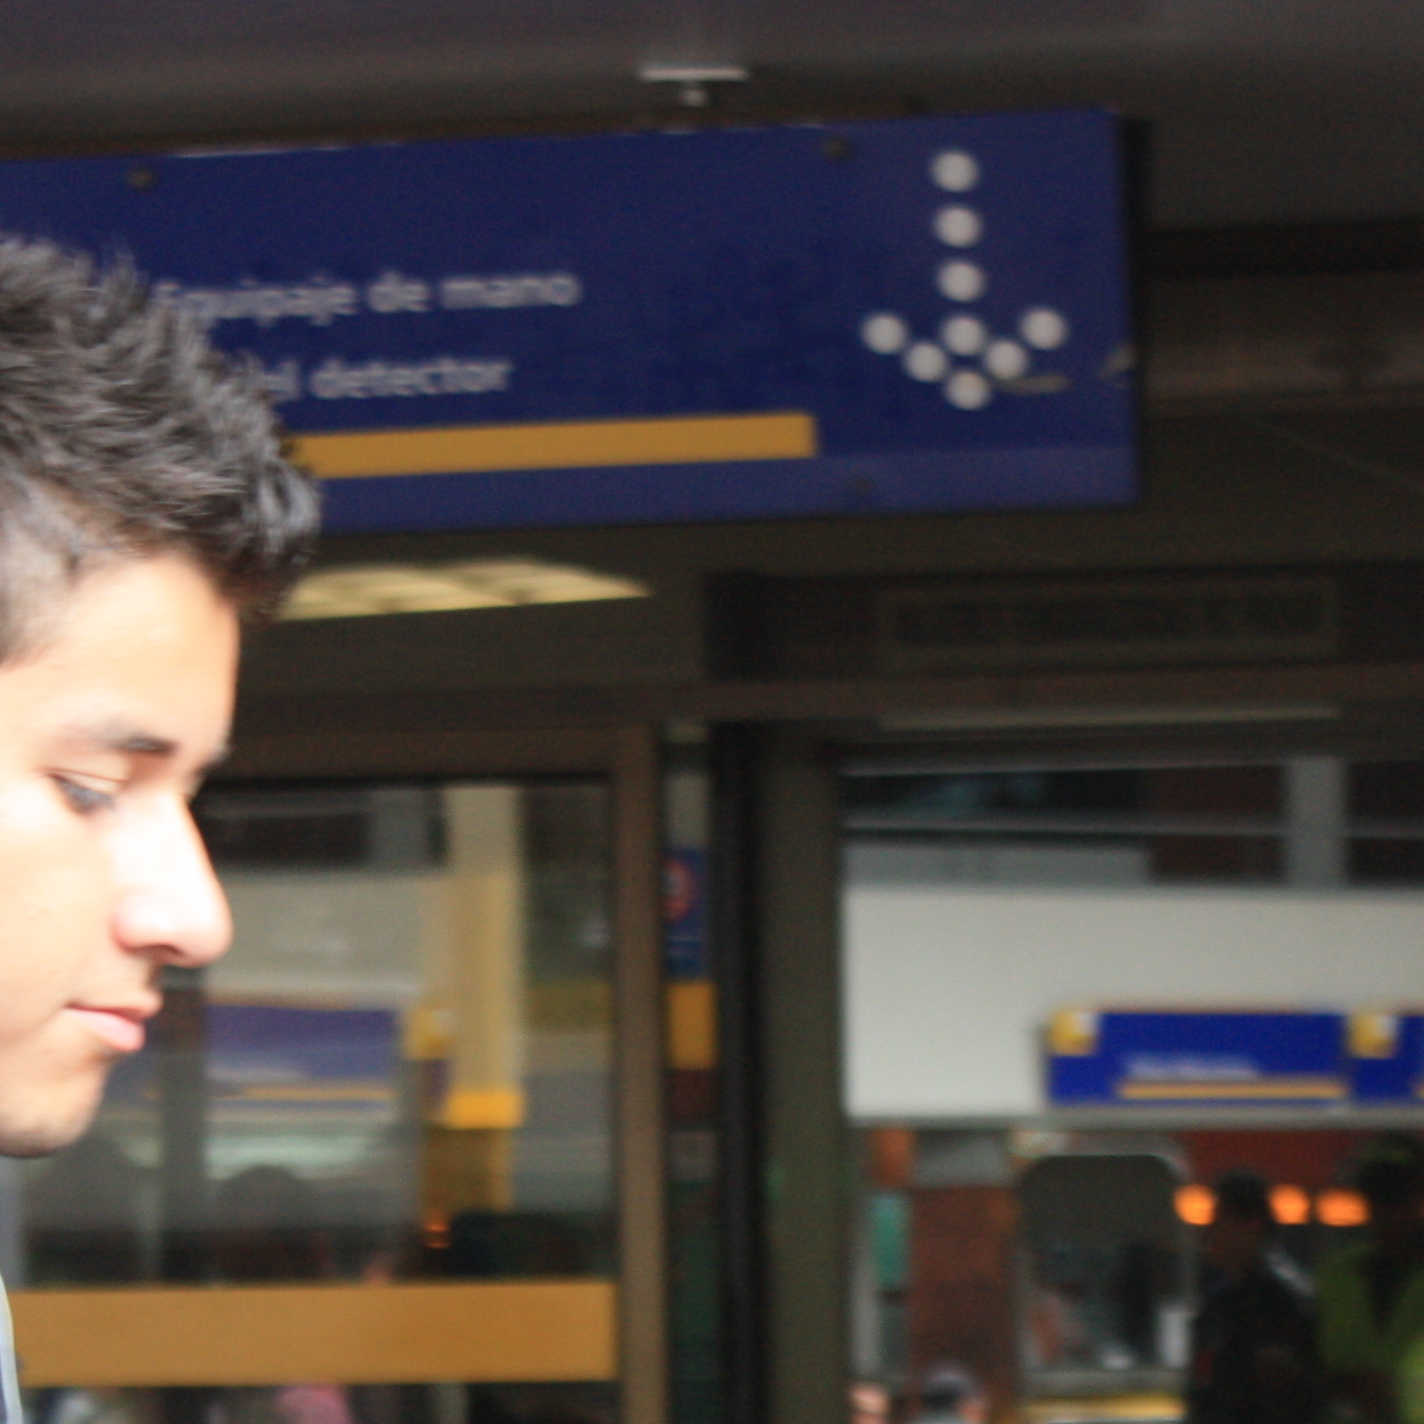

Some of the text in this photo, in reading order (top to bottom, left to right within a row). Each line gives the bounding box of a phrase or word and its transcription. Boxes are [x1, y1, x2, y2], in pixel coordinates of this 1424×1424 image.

[368, 271, 431, 313] de
[438, 273, 583, 310] mano
[310, 357, 513, 400] detector
